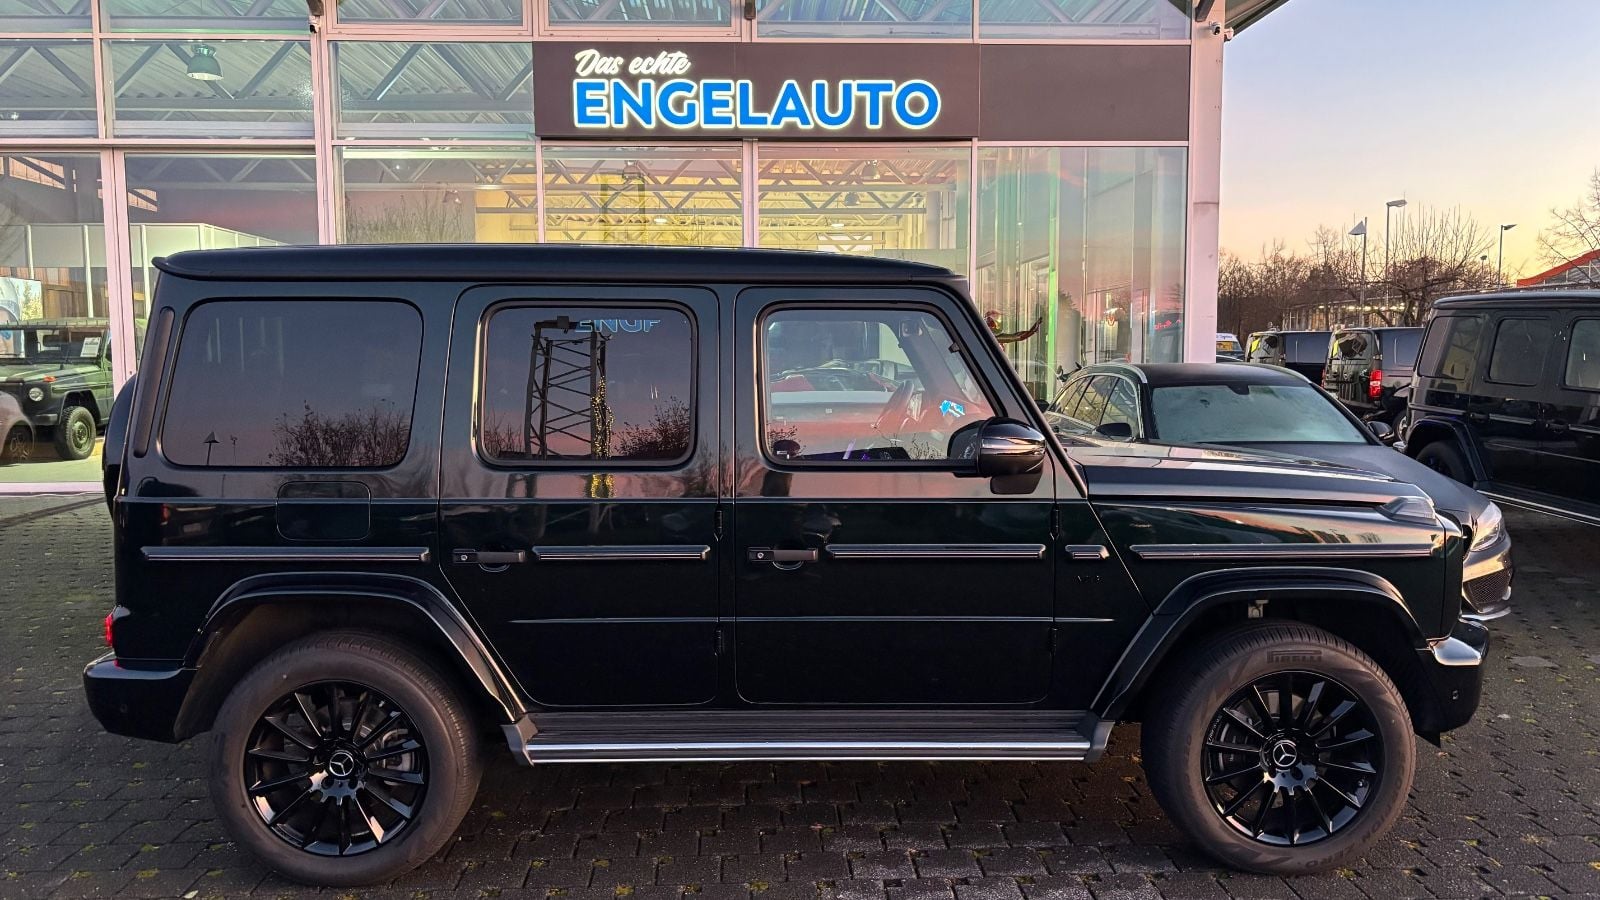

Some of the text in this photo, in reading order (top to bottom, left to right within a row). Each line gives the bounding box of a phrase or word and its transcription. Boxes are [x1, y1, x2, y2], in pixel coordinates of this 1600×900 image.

[575, 49, 691, 76] Das echte
[573, 79, 942, 129] ENGELAUTO
[1267, 650, 1322, 663] PIRELLI
